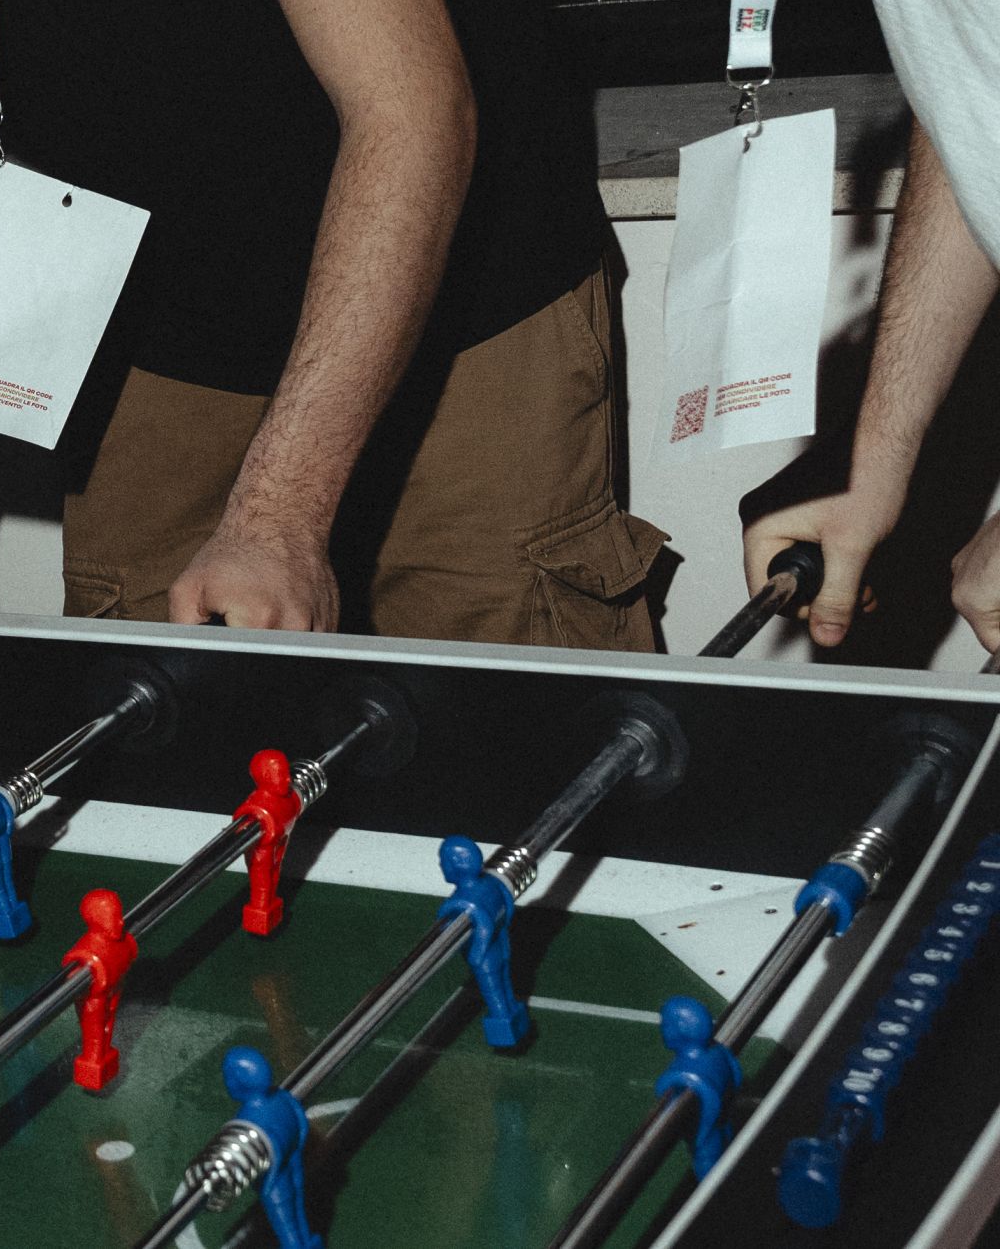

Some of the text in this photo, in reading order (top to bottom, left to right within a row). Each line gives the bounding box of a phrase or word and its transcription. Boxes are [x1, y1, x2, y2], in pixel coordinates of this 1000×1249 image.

[770, 373, 792, 382] CODE
[36, 391, 53, 400] CODE
[770, 388, 791, 397] FOTO
[31, 402, 48, 411] FOTO
[966, 881, 994, 893] 2
[951, 903, 980, 916] 3
[938, 926, 964, 938] 4
[923, 949, 954, 962] 5
[908, 973, 938, 986] 6
[894, 998, 925, 1012] 7
[877, 1020, 910, 1036] 8
[862, 1047, 894, 1062] 9
[842, 1069, 881, 1093] 10
